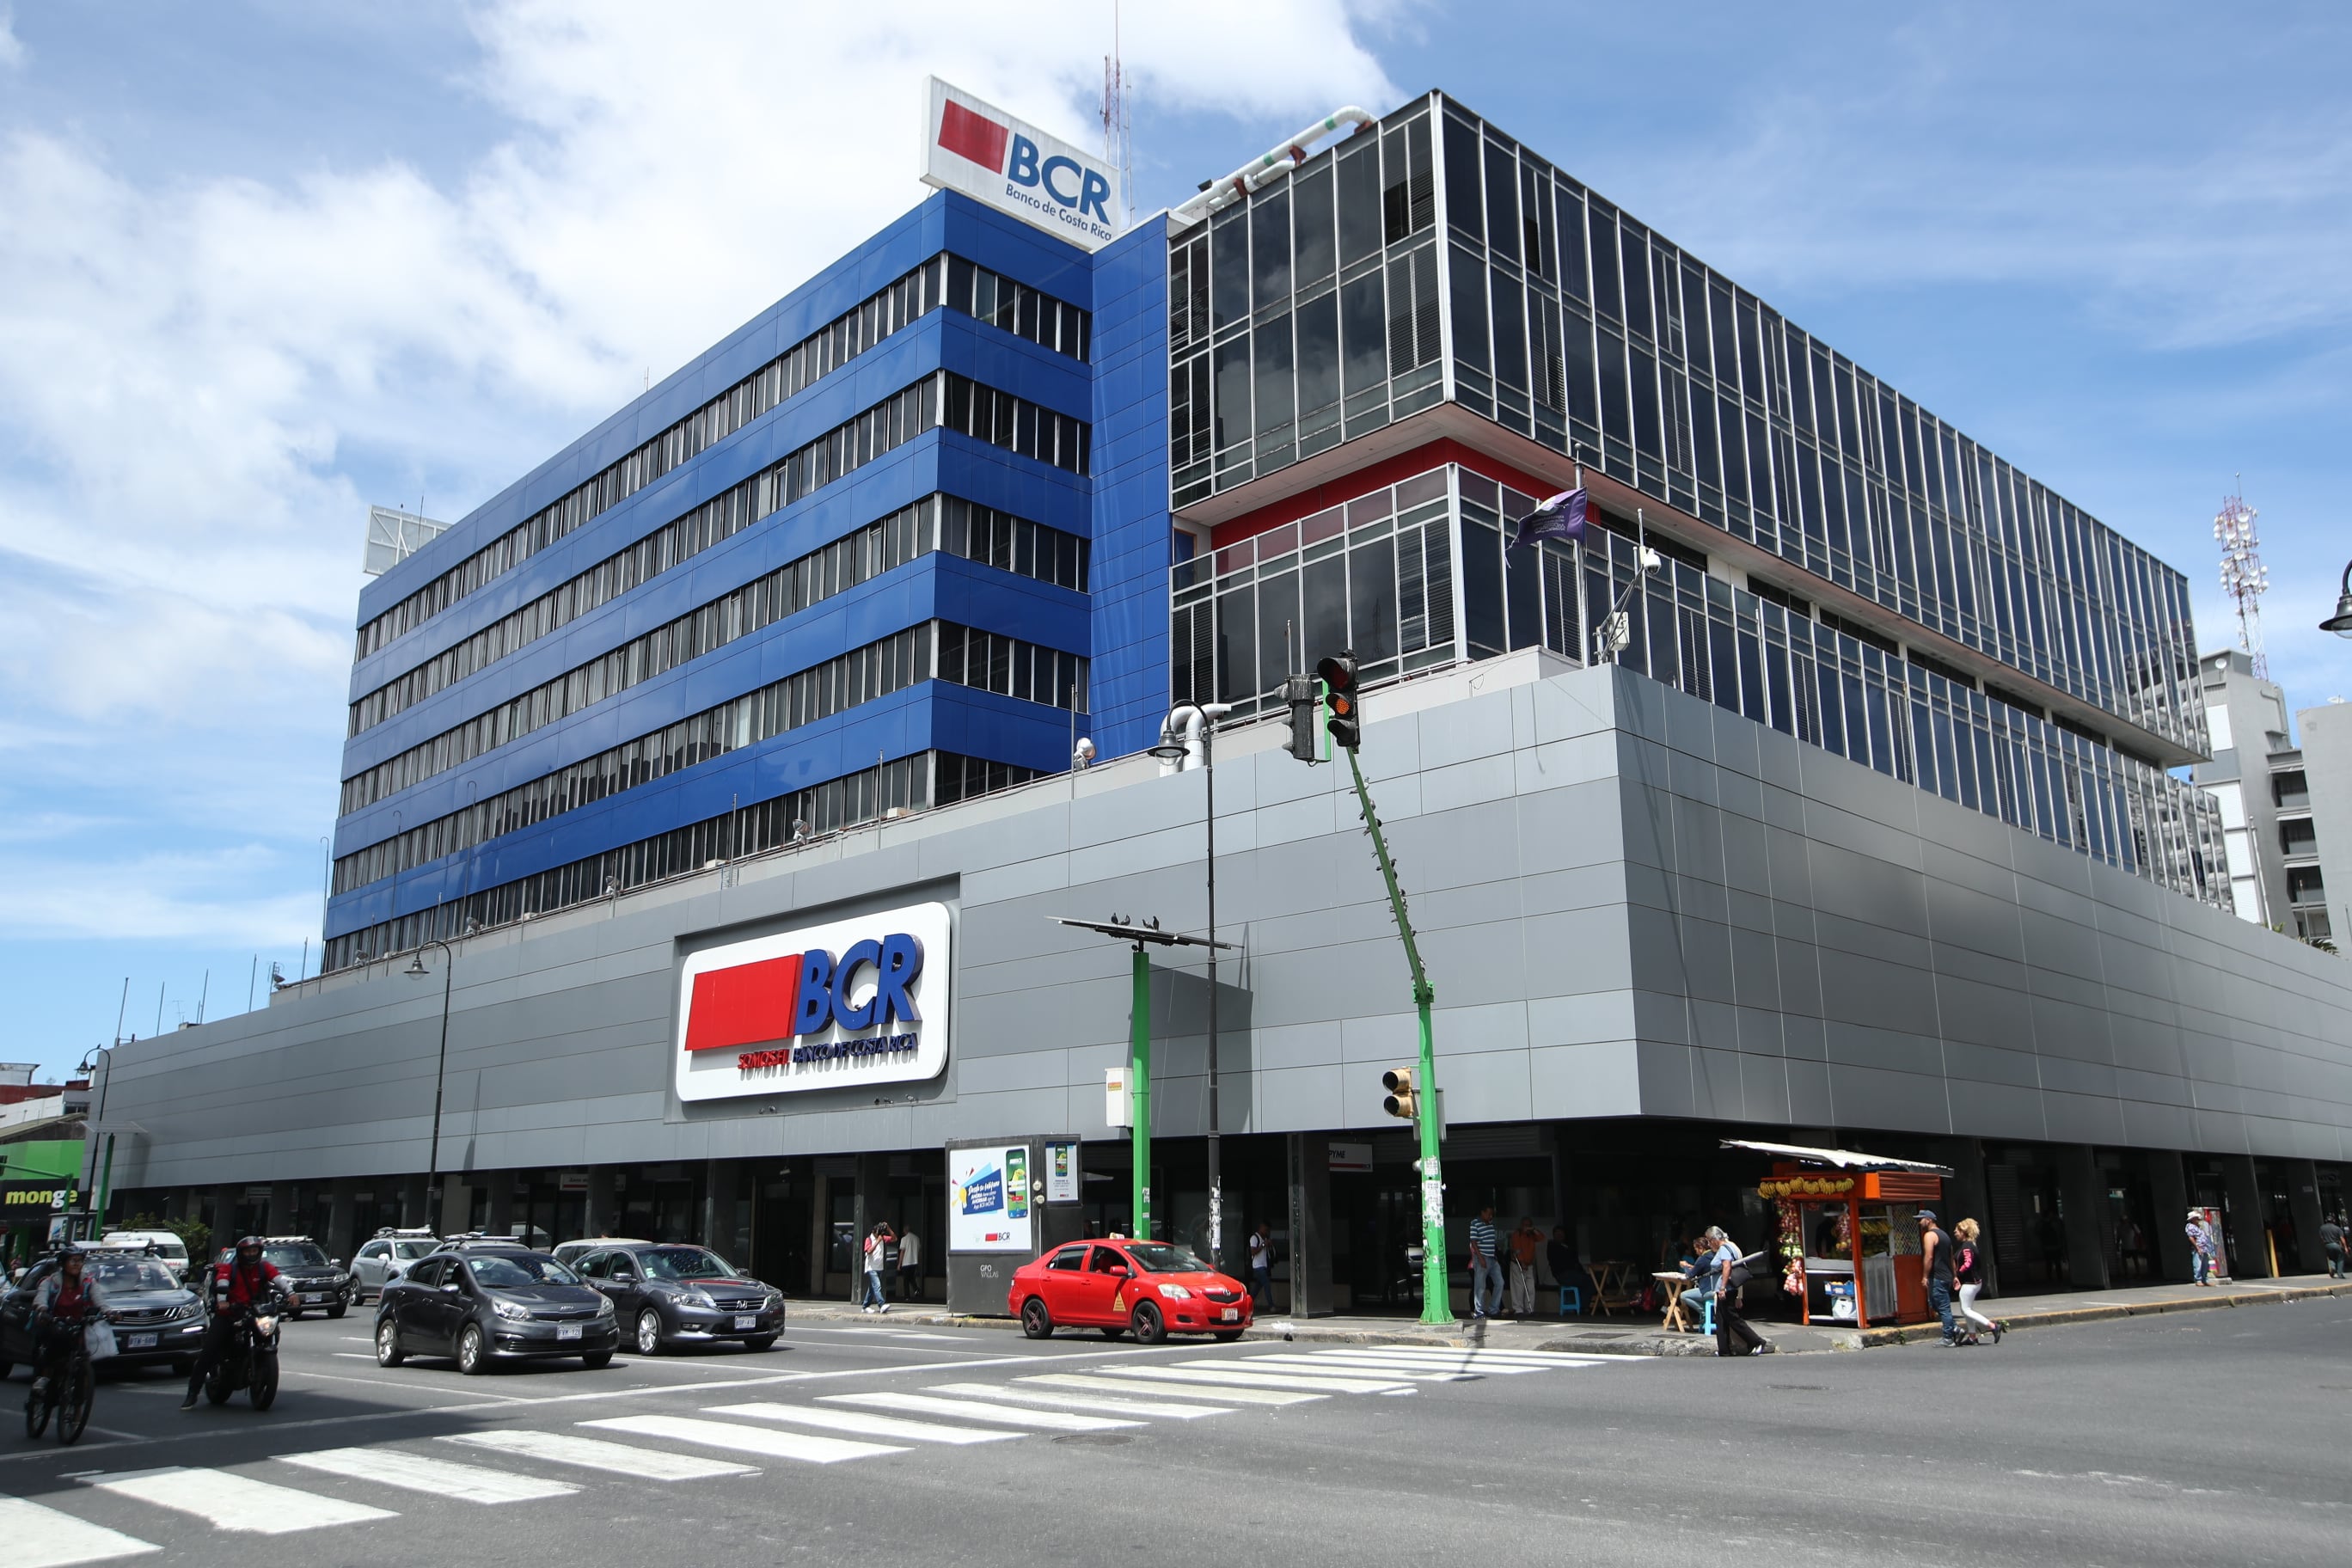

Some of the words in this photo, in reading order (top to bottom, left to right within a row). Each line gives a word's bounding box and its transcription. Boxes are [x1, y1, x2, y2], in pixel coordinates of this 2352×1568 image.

[1008, 132, 1111, 226] BCR
[1006, 183, 1040, 209] Banco
[1042, 201, 1057, 217] de
[1059, 208, 1088, 231] Costa
[1090, 222, 1112, 242] Rica
[793, 933, 924, 1035] BCR
[793, 1044, 834, 1063] BANCO
[834, 1041, 849, 1058] DE
[850, 1036, 888, 1057] COSTA
[889, 1032, 918, 1052] RICA
[5, 1190, 78, 1209] monge
[998, 1232, 1010, 1240] BCR
